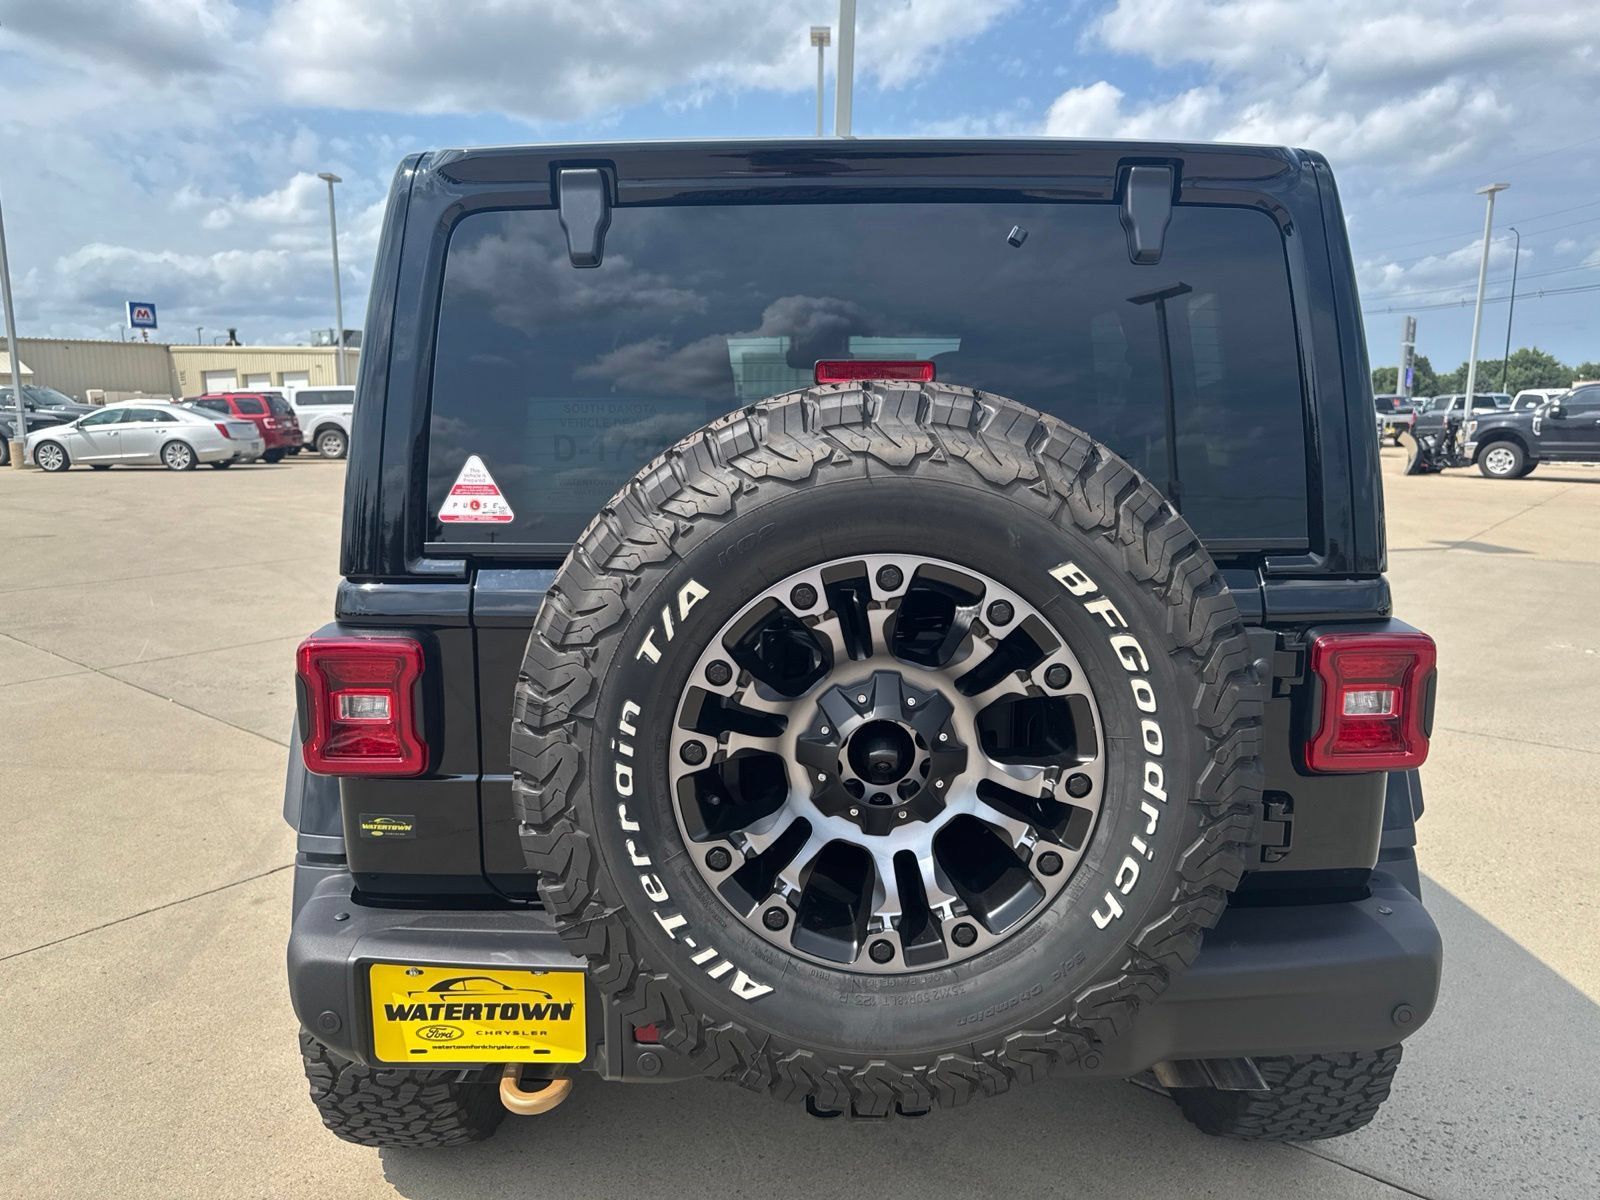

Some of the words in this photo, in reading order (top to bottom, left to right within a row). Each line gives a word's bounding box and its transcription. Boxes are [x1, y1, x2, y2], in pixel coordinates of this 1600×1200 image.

[563, 403, 605, 414] SOUTH
[608, 403, 657, 414] DAKOTA
[560, 417, 609, 428] VEHICLE
[453, 501, 498, 510] PULSE
[636, 579, 710, 664] T/A
[1048, 560, 1168, 931] BFGoodrich
[361, 823, 413, 831] WATERTOWN
[611, 699, 775, 1000] All-Terrain
[384, 1002, 572, 1022] WATERTOWN
